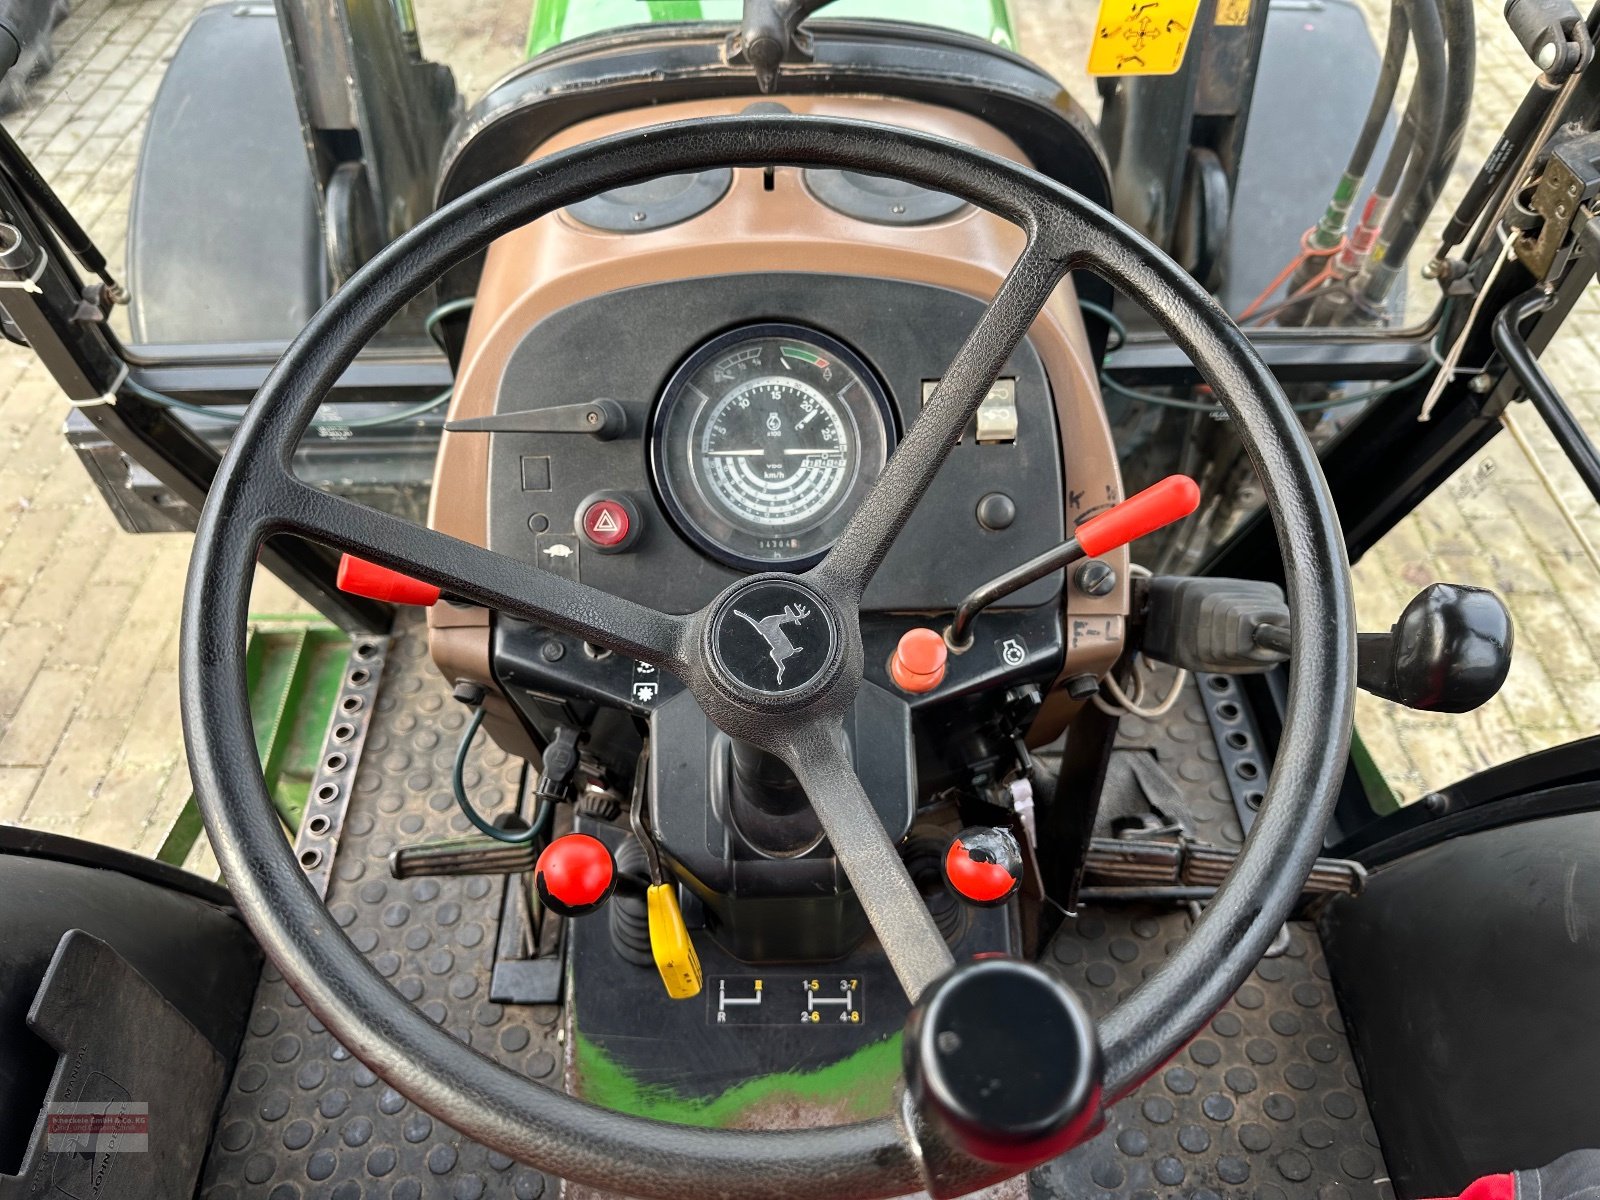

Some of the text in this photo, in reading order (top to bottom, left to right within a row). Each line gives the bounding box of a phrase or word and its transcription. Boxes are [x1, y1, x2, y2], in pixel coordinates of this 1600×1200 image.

[771, 390, 782, 400] 15
[738, 398, 750, 410] 10
[800, 400, 813, 413] 20
[821, 427, 833, 441] 25
[763, 471, 785, 479] km/h
[717, 1011, 726, 1023] R
[93, 1153, 111, 1195] JOHN
